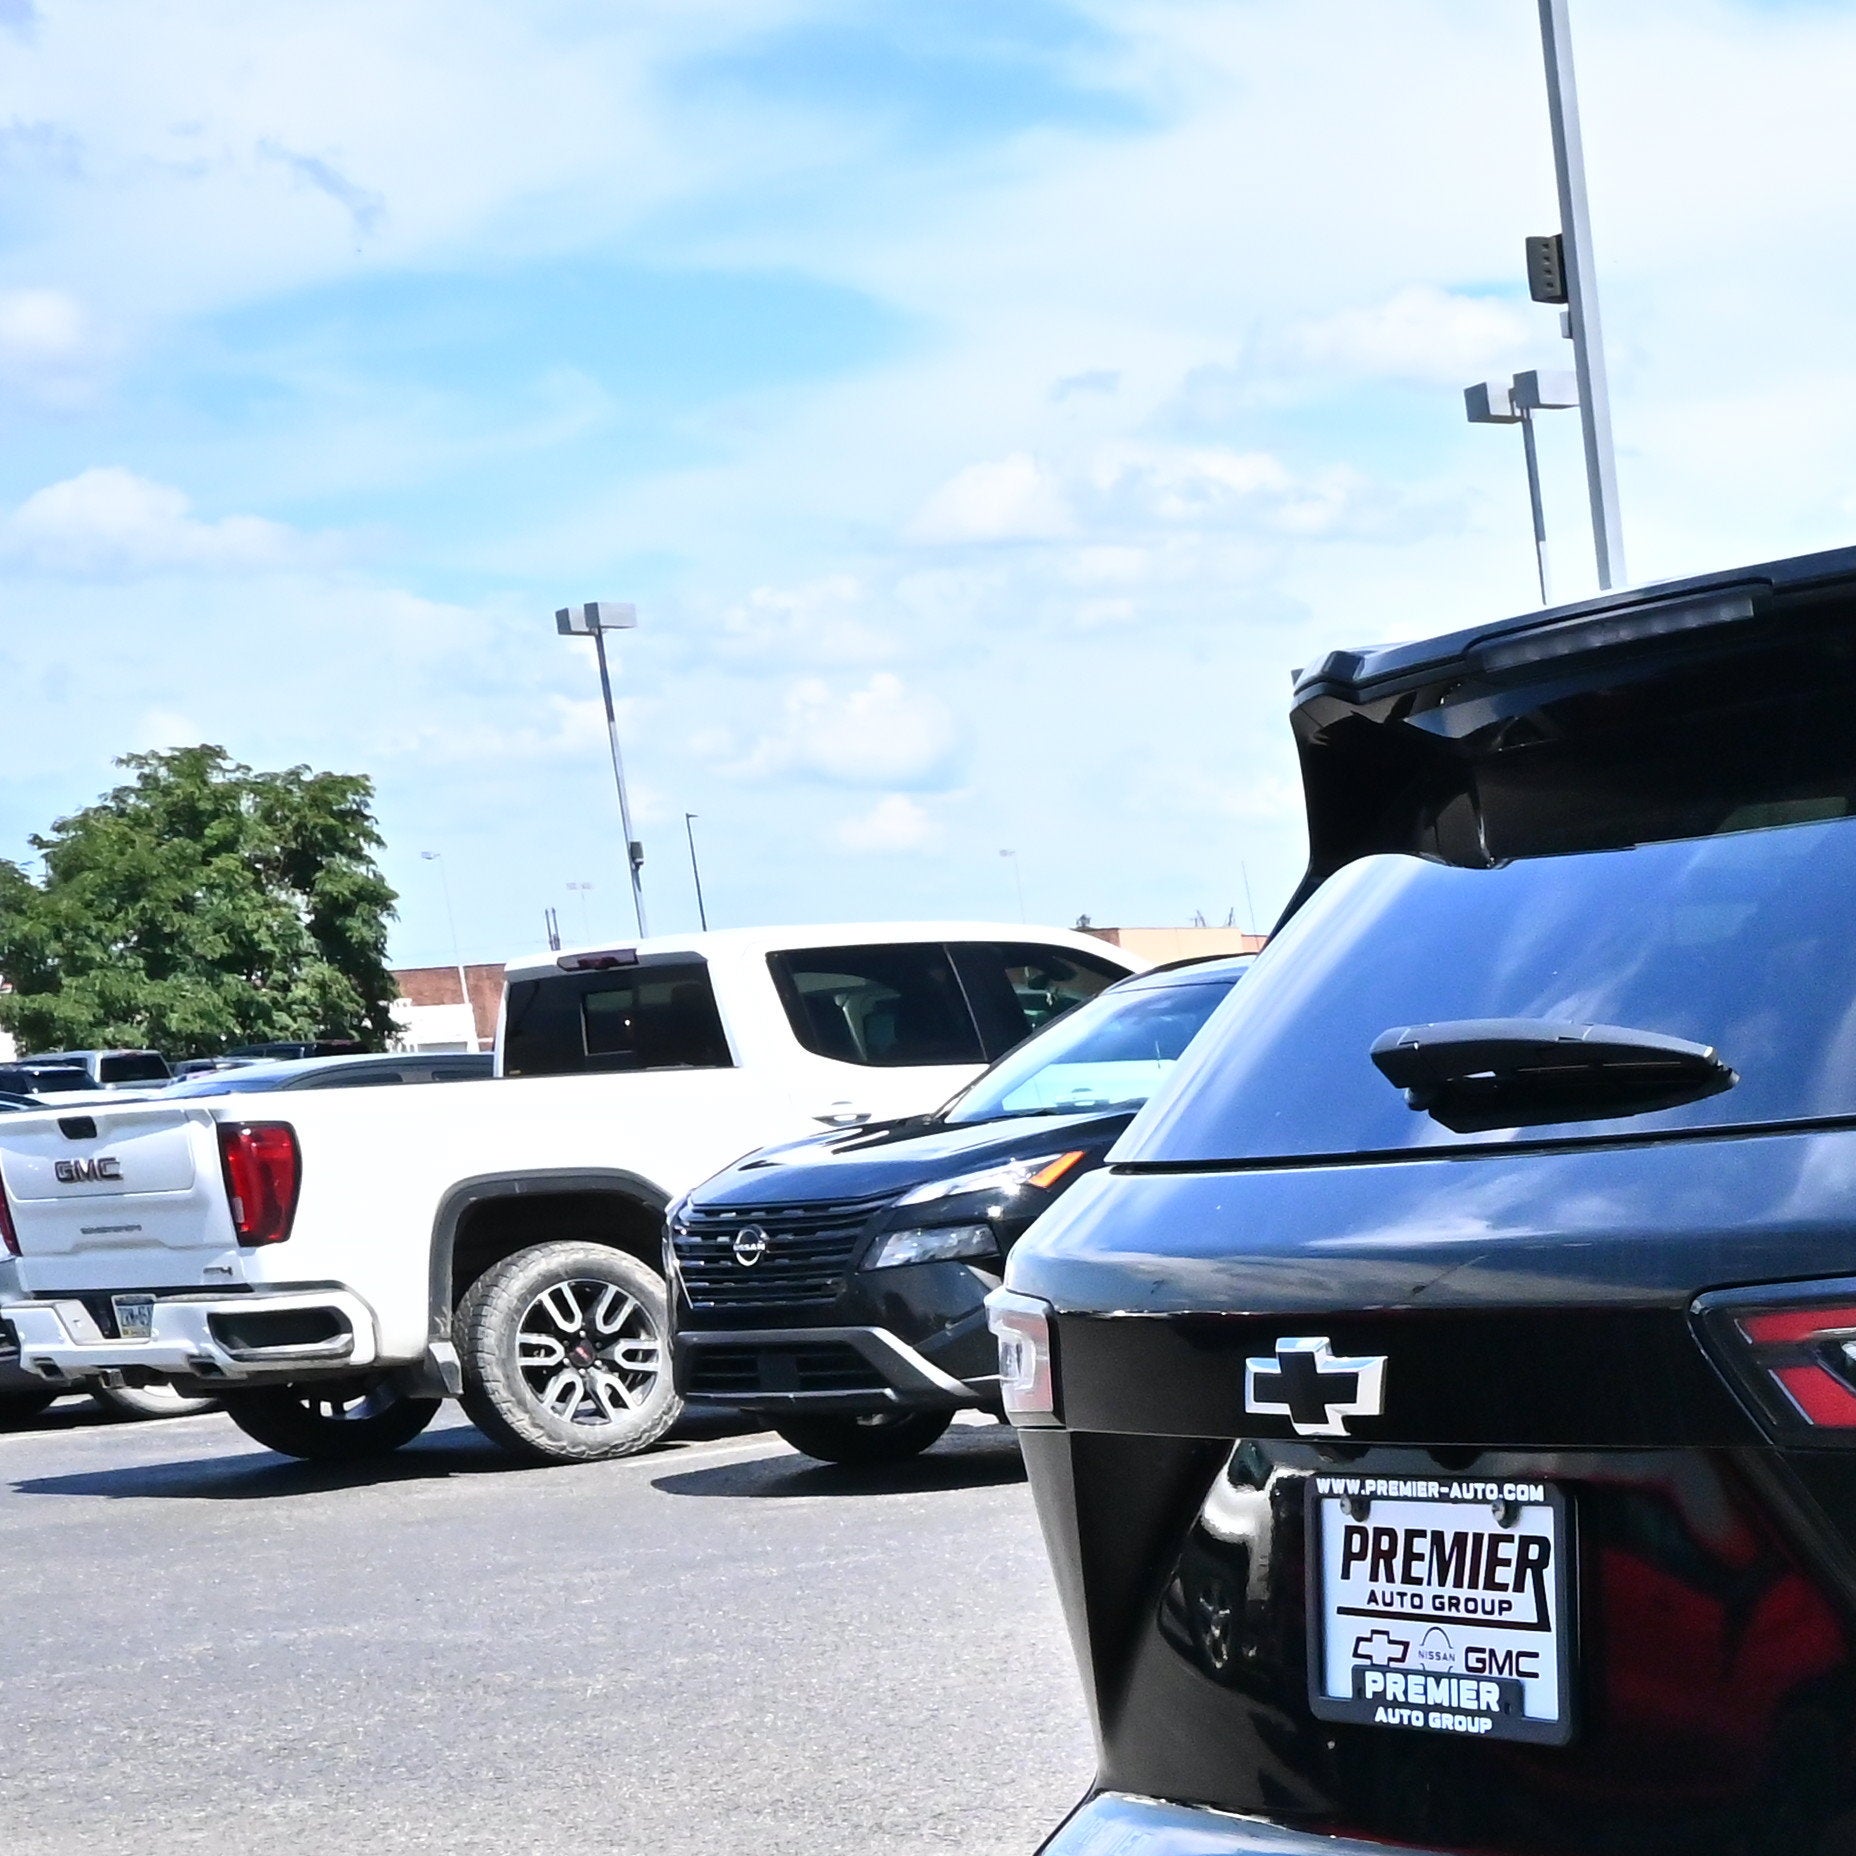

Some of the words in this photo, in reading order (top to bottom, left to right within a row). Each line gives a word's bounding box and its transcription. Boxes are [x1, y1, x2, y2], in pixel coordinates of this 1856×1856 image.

[55, 1157, 123, 1183] GMC
[1316, 1477, 1545, 1502] WWW.PREMIER-AUTO.COM
[1340, 1524, 1552, 1594] PREMIER
[1366, 1589, 1424, 1611] AUTO
[1430, 1594, 1514, 1617] GROUP
[1417, 1650, 1456, 1662] NISSAN
[1464, 1646, 1540, 1679] GMC
[1364, 1671, 1501, 1712] PREMIER
[1374, 1706, 1425, 1727] AUTO
[1428, 1711, 1493, 1734] GROUP
